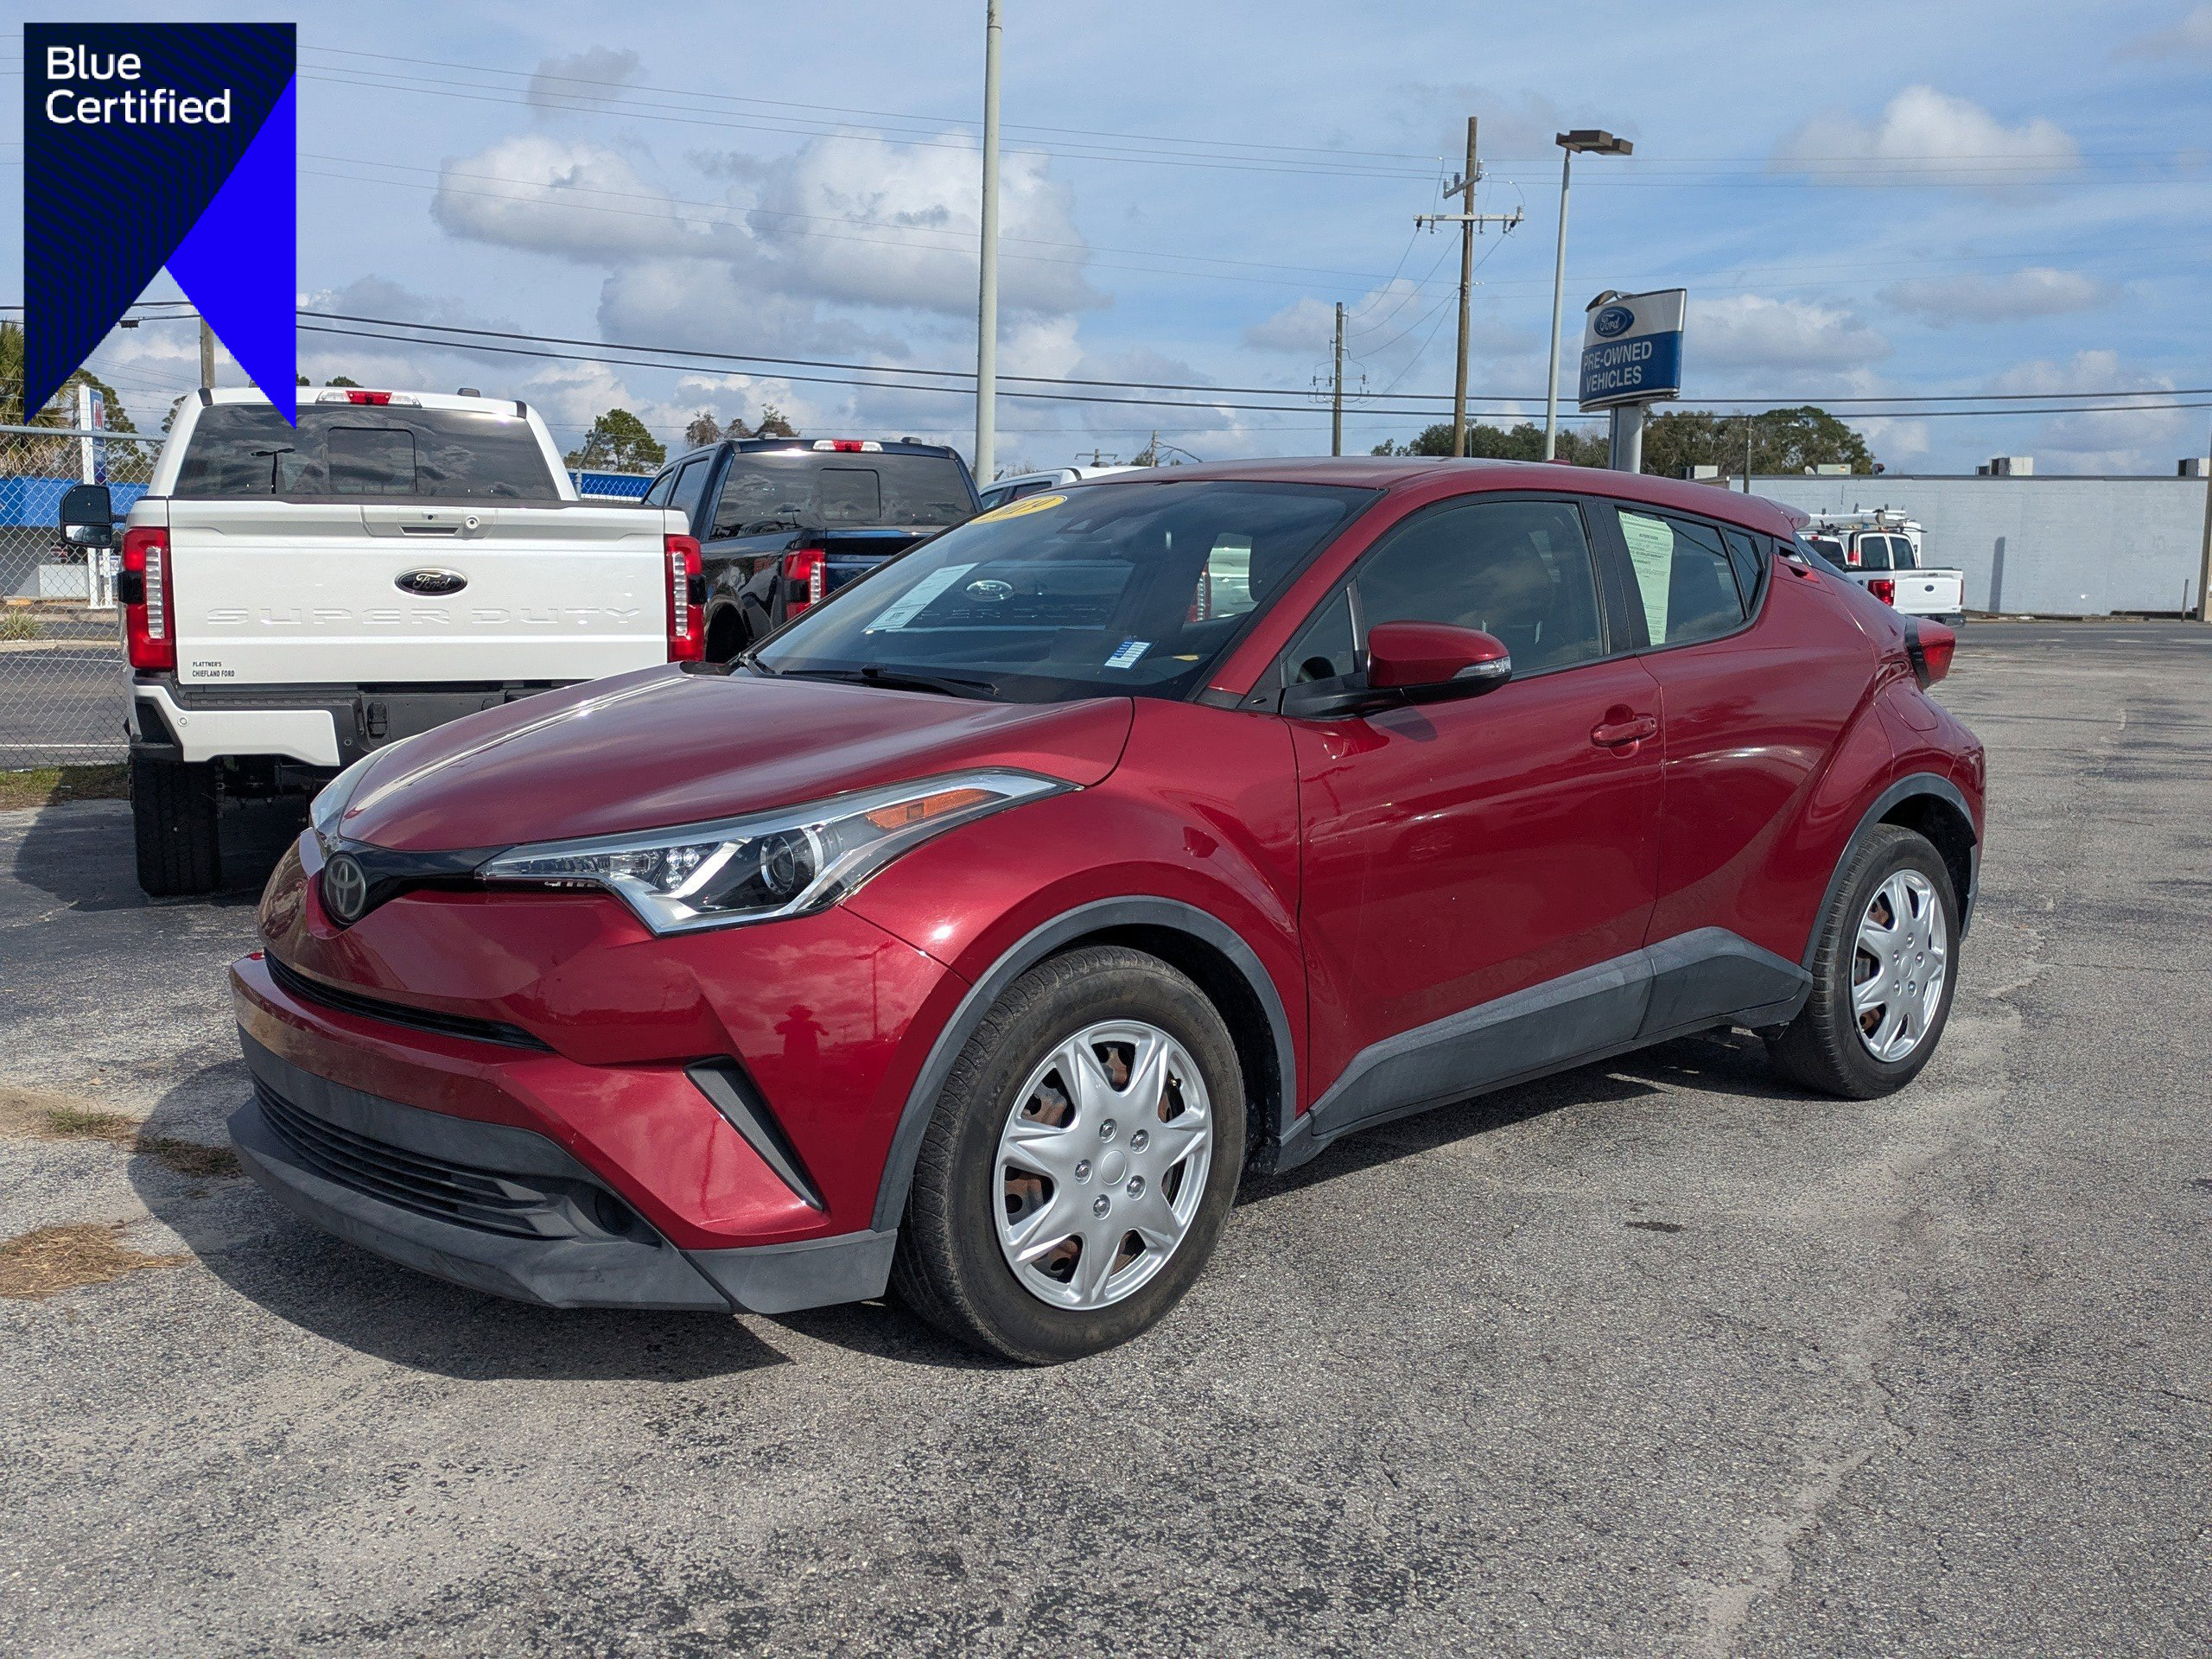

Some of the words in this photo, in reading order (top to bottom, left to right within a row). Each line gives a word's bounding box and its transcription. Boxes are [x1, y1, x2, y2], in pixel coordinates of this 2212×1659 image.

[1600, 314, 1620, 332] Ford
[1583, 340, 1652, 372] PRE-OWNED
[1586, 365, 1642, 393] VEHICLES
[413, 573, 451, 589] Ford
[207, 608, 449, 625] SUPER
[472, 607, 640, 625] DUTY
